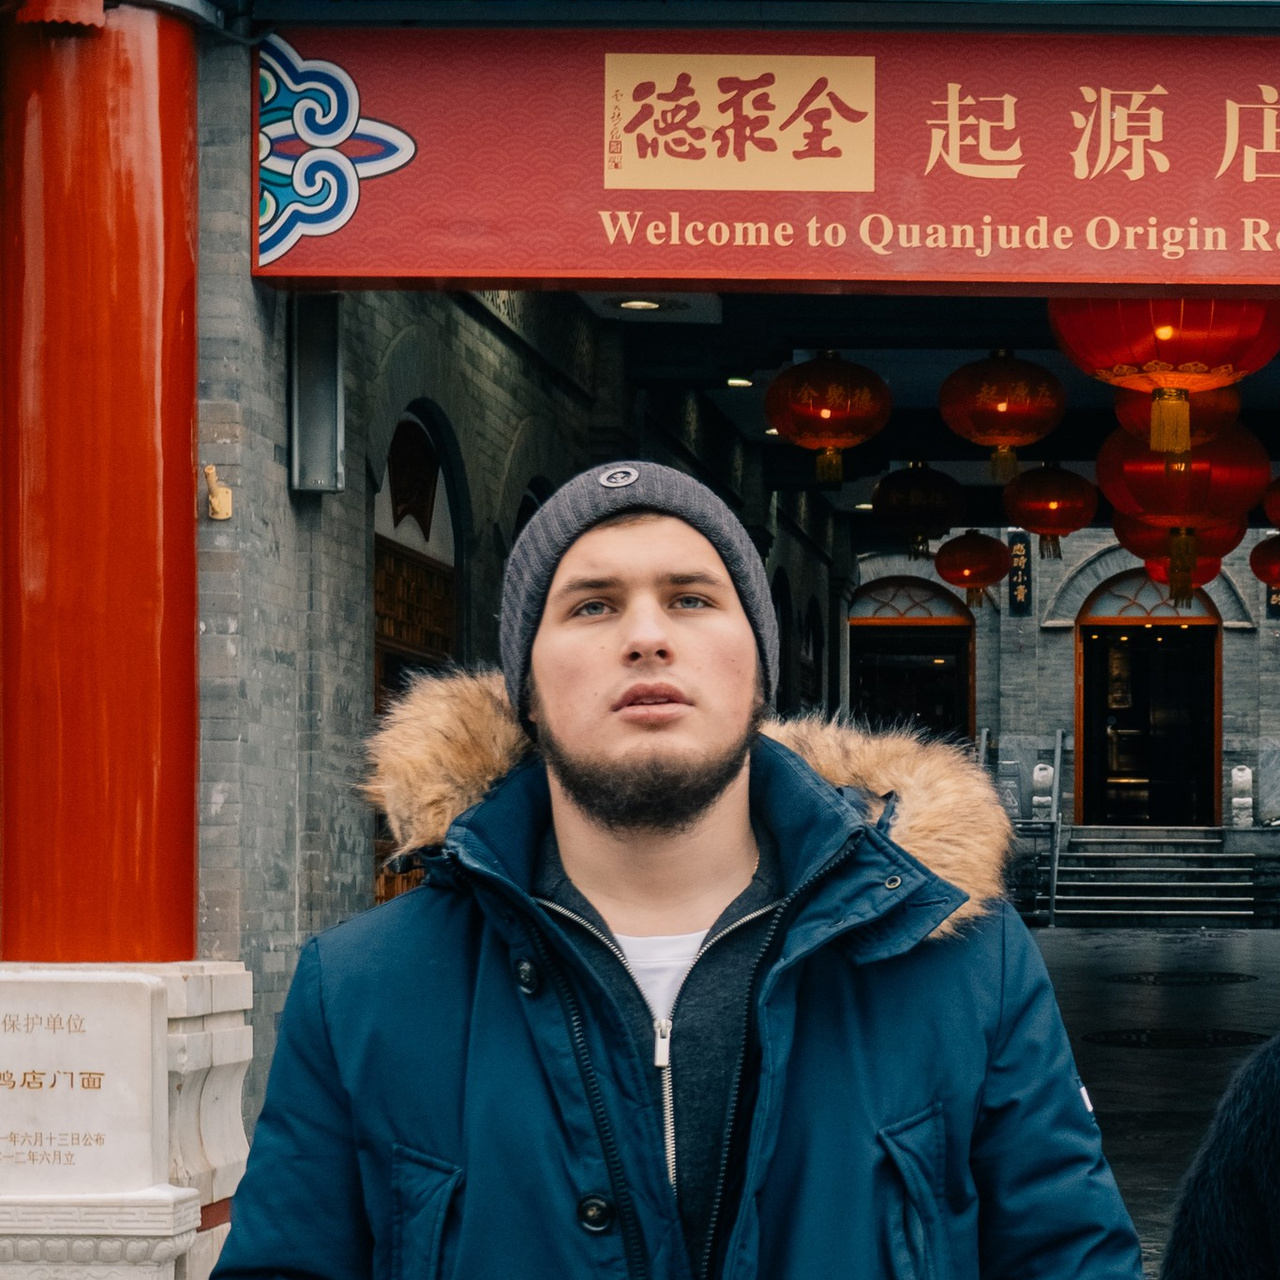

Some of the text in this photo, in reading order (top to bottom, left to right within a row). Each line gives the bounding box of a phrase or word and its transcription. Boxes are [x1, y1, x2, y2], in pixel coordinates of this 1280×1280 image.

[598, 211, 794, 247] Welcome
[806, 215, 847, 248] to
[858, 213, 1074, 259] Quanjude
[1085, 215, 1228, 260] Origin
[2, 1012, 87, 1035] 保护单位
[0, 1150, 76, 1166] 一二年六月立
